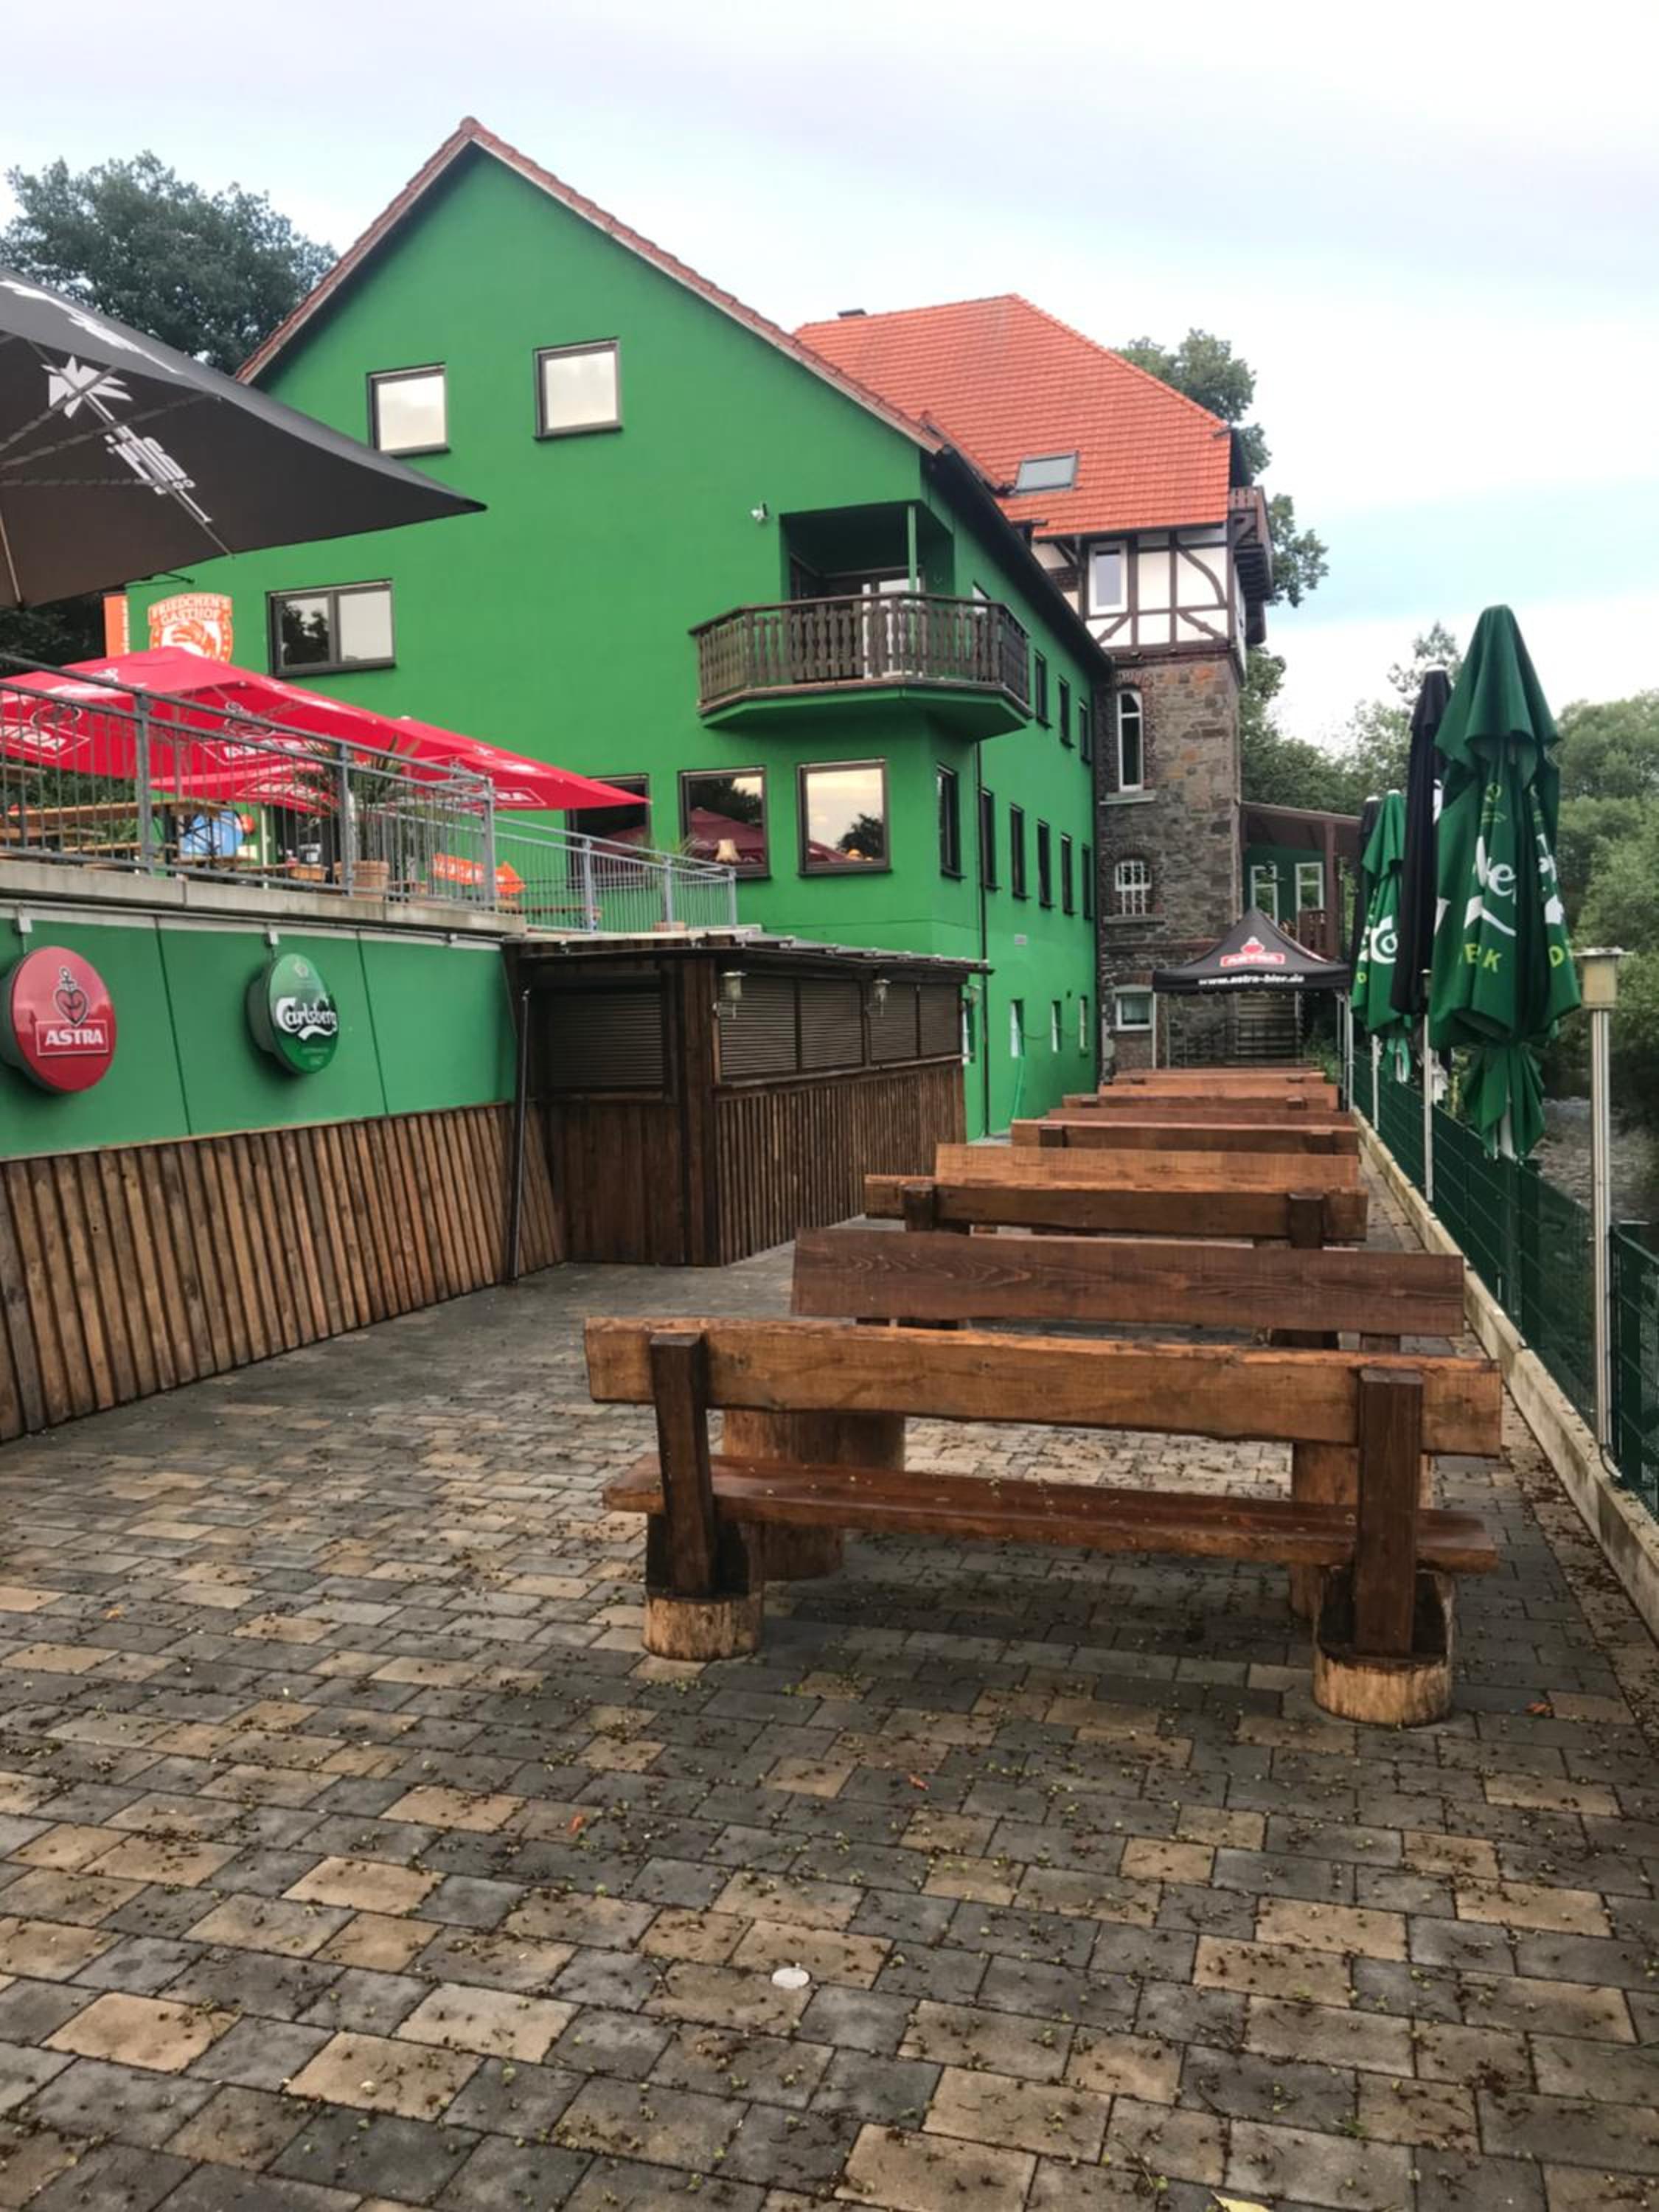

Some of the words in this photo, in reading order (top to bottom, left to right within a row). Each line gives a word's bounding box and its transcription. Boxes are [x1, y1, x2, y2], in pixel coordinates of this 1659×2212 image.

[160, 607, 220, 626] GASTHOF
[1197, 974, 1305, 986] www.astra-bier.de
[276, 996, 338, 1034] Carlsberg
[45, 1028, 105, 1046] ASTRA
